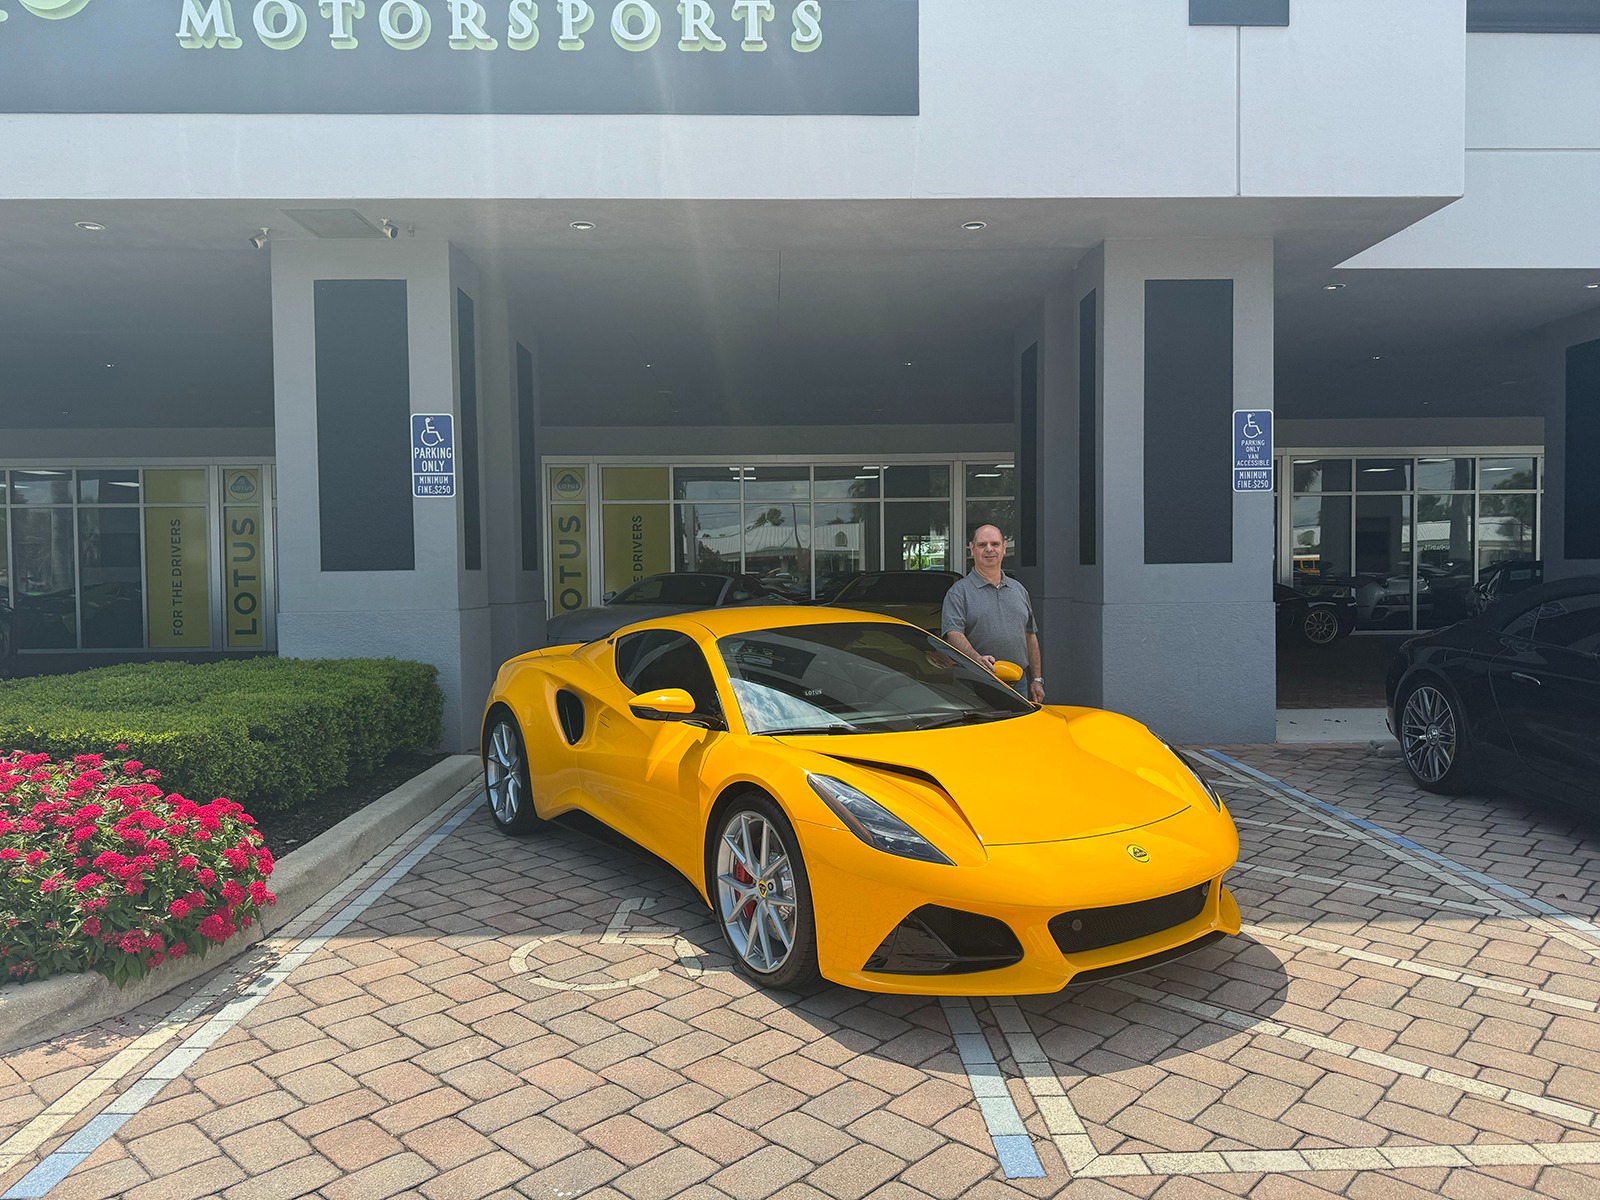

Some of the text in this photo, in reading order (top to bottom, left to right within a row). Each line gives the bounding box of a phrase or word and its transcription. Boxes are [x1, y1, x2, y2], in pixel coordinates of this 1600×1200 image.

[175, 0, 823, 51] MOTORSPORTS
[414, 447, 452, 459] PARKING
[421, 461, 445, 472] ONLY
[417, 485, 451, 494] FINE $250
[419, 476, 449, 484] MINIMUM
[1239, 471, 1267, 479] MINIMUM
[632, 515, 643, 572] DRIVERS
[170, 519, 184, 636] FOR THE DRIVERS
[231, 517, 257, 635] LOTUS
[558, 515, 582, 611] OTUS
